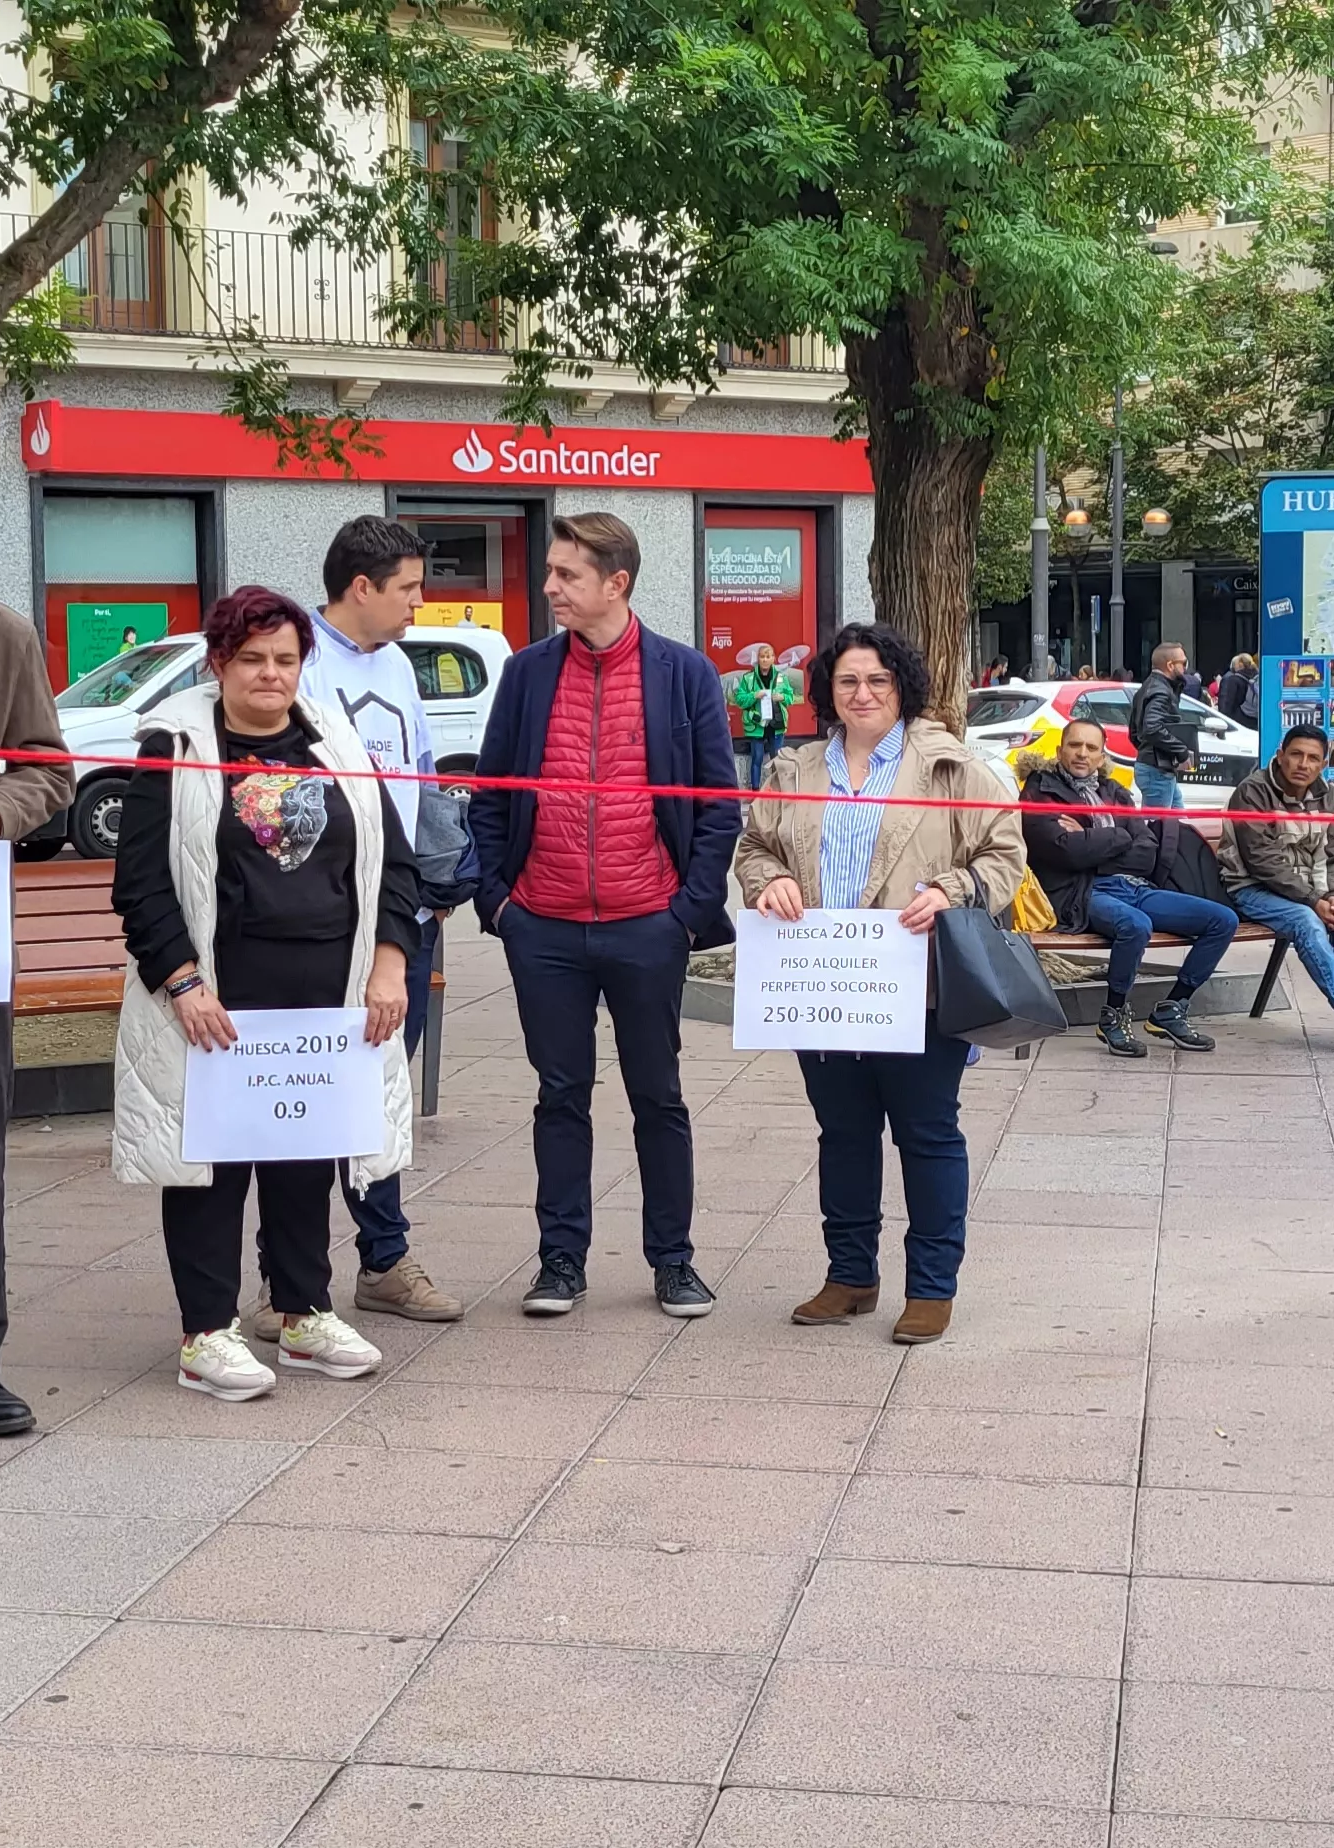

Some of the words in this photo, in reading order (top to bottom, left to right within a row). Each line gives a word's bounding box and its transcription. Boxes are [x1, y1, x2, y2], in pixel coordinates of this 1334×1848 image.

[499, 440, 661, 476] Santander
[711, 565, 769, 574] ESPECIALIZADA
[711, 575, 720, 584] EL
[722, 575, 757, 584] NEGOCIO
[758, 575, 780, 584] AGRO
[1234, 577, 1259, 590] Caix
[712, 636, 732, 649] Agro
[1182, 774, 1223, 782] NOTICIAS
[777, 927, 828, 940] HUESCA
[832, 922, 884, 939] 2019
[780, 957, 809, 969] PISO
[812, 957, 878, 970] ALQUILER
[761, 981, 826, 993] PERPETUO
[830, 982, 898, 994] SOCORRO
[763, 1006, 843, 1023] 250-300
[847, 1013, 893, 1025] EUROS
[234, 1042, 291, 1056] HUESCA
[295, 1034, 348, 1054] 2019
[247, 1073, 281, 1087] I.P.C.
[285, 1072, 334, 1086] ANUAL
[273, 1100, 306, 1119] 0.9
